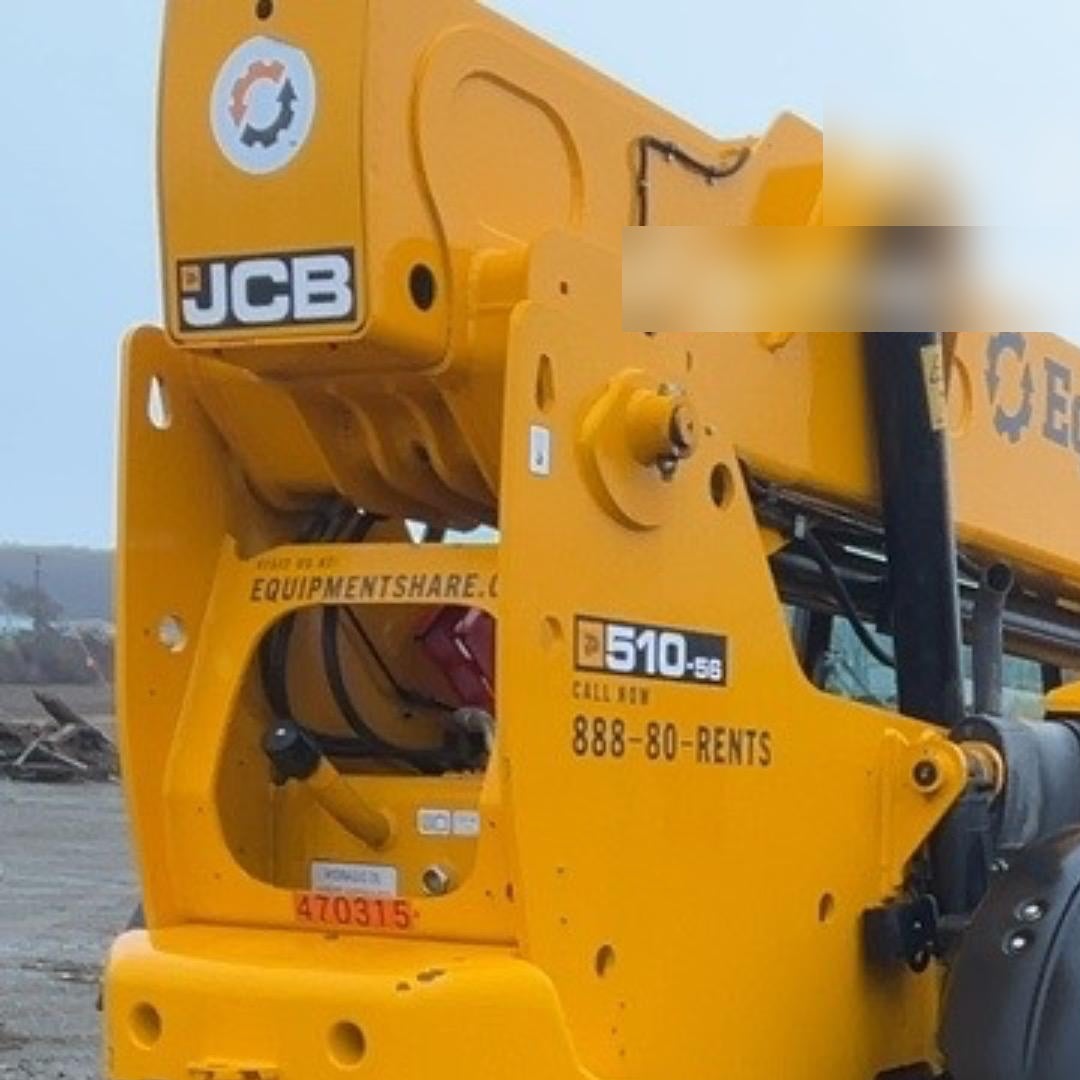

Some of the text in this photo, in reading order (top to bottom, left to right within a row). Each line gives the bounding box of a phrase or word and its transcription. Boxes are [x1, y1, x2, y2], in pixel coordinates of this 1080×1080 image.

[181, 254, 353, 327] JCB
[605, 623, 723, 683] 510-56
[572, 681, 610, 703] CALL
[573, 715, 772, 767] 888-80-RENTS
[297, 894, 410, 929] 470315
